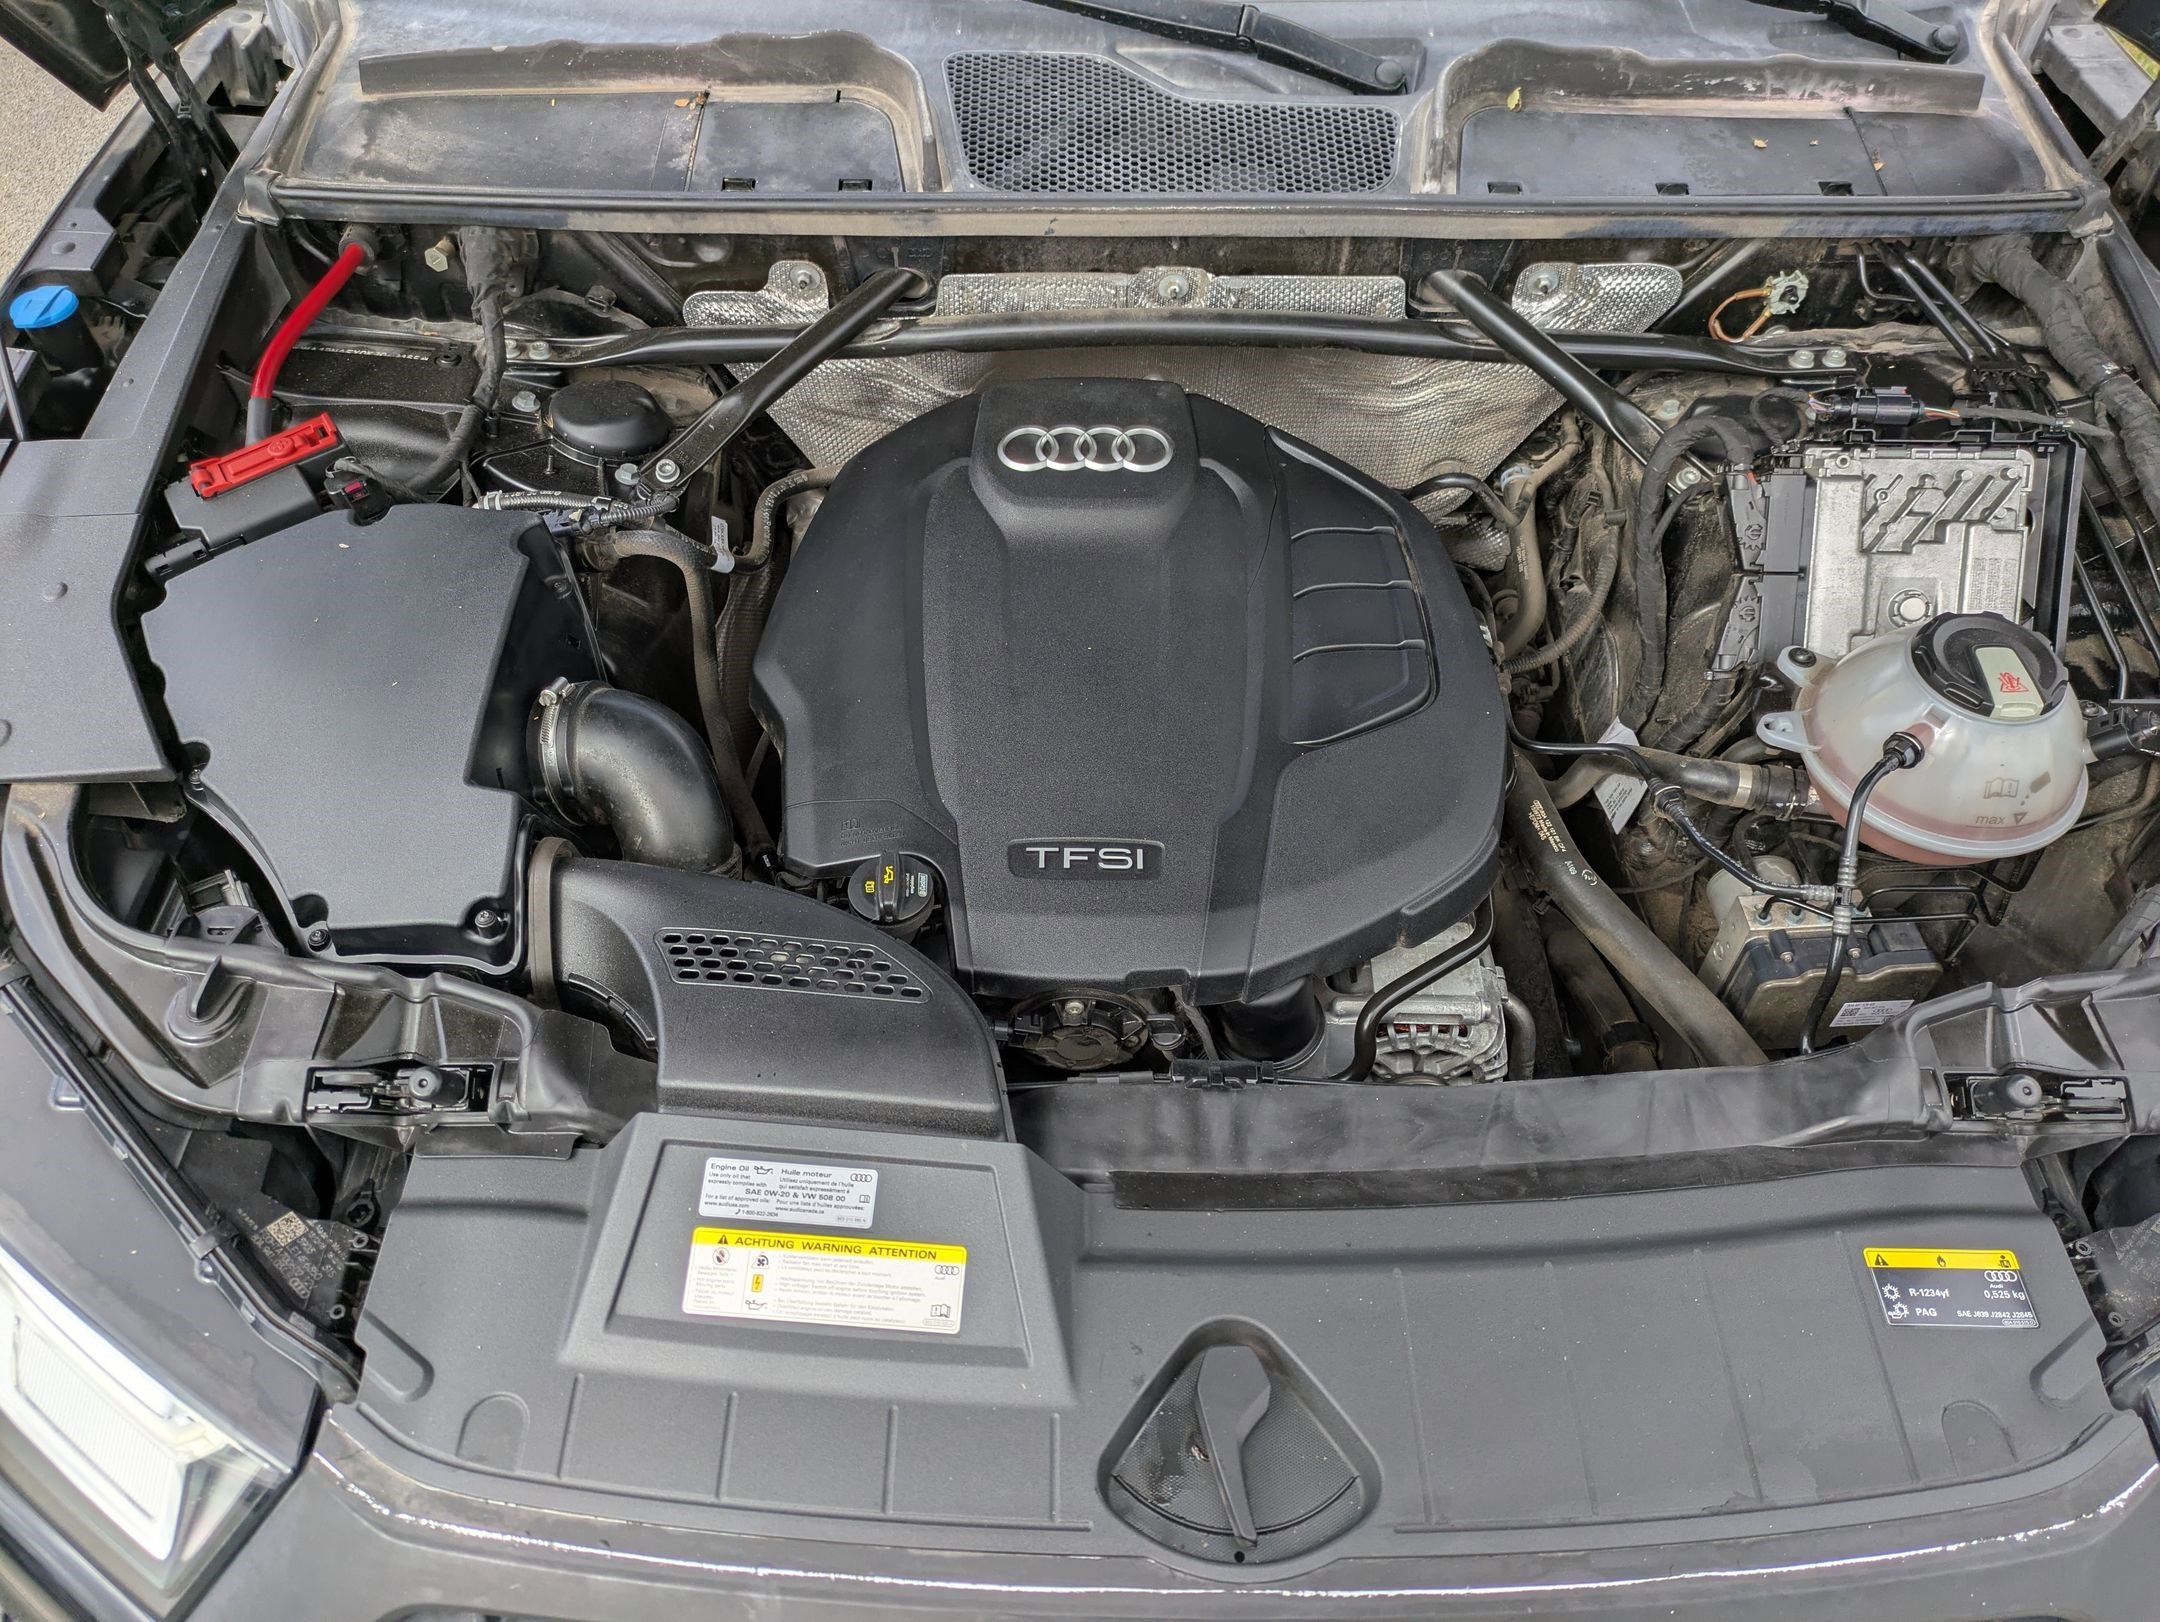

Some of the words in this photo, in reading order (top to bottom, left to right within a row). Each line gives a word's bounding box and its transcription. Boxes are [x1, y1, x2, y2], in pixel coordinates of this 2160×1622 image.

[1975, 815, 2006, 825] max
[1026, 847, 1144, 870] TFSI
[710, 1163, 736, 1171] Engine
[802, 1170, 832, 1178] moteur
[763, 1189, 790, 1198] 0W-20
[734, 1236, 795, 1250] ACHTUNG
[801, 1241, 862, 1255] WARNING
[868, 1246, 937, 1260] ATTENTION
[1908, 1288, 1950, 1299] R-1234yf
[1983, 1290, 2010, 1299] 0,525
[2012, 1290, 2025, 1301] kg
[1915, 1307, 1938, 1317] PAG
[1956, 1310, 1971, 1318] SAE
